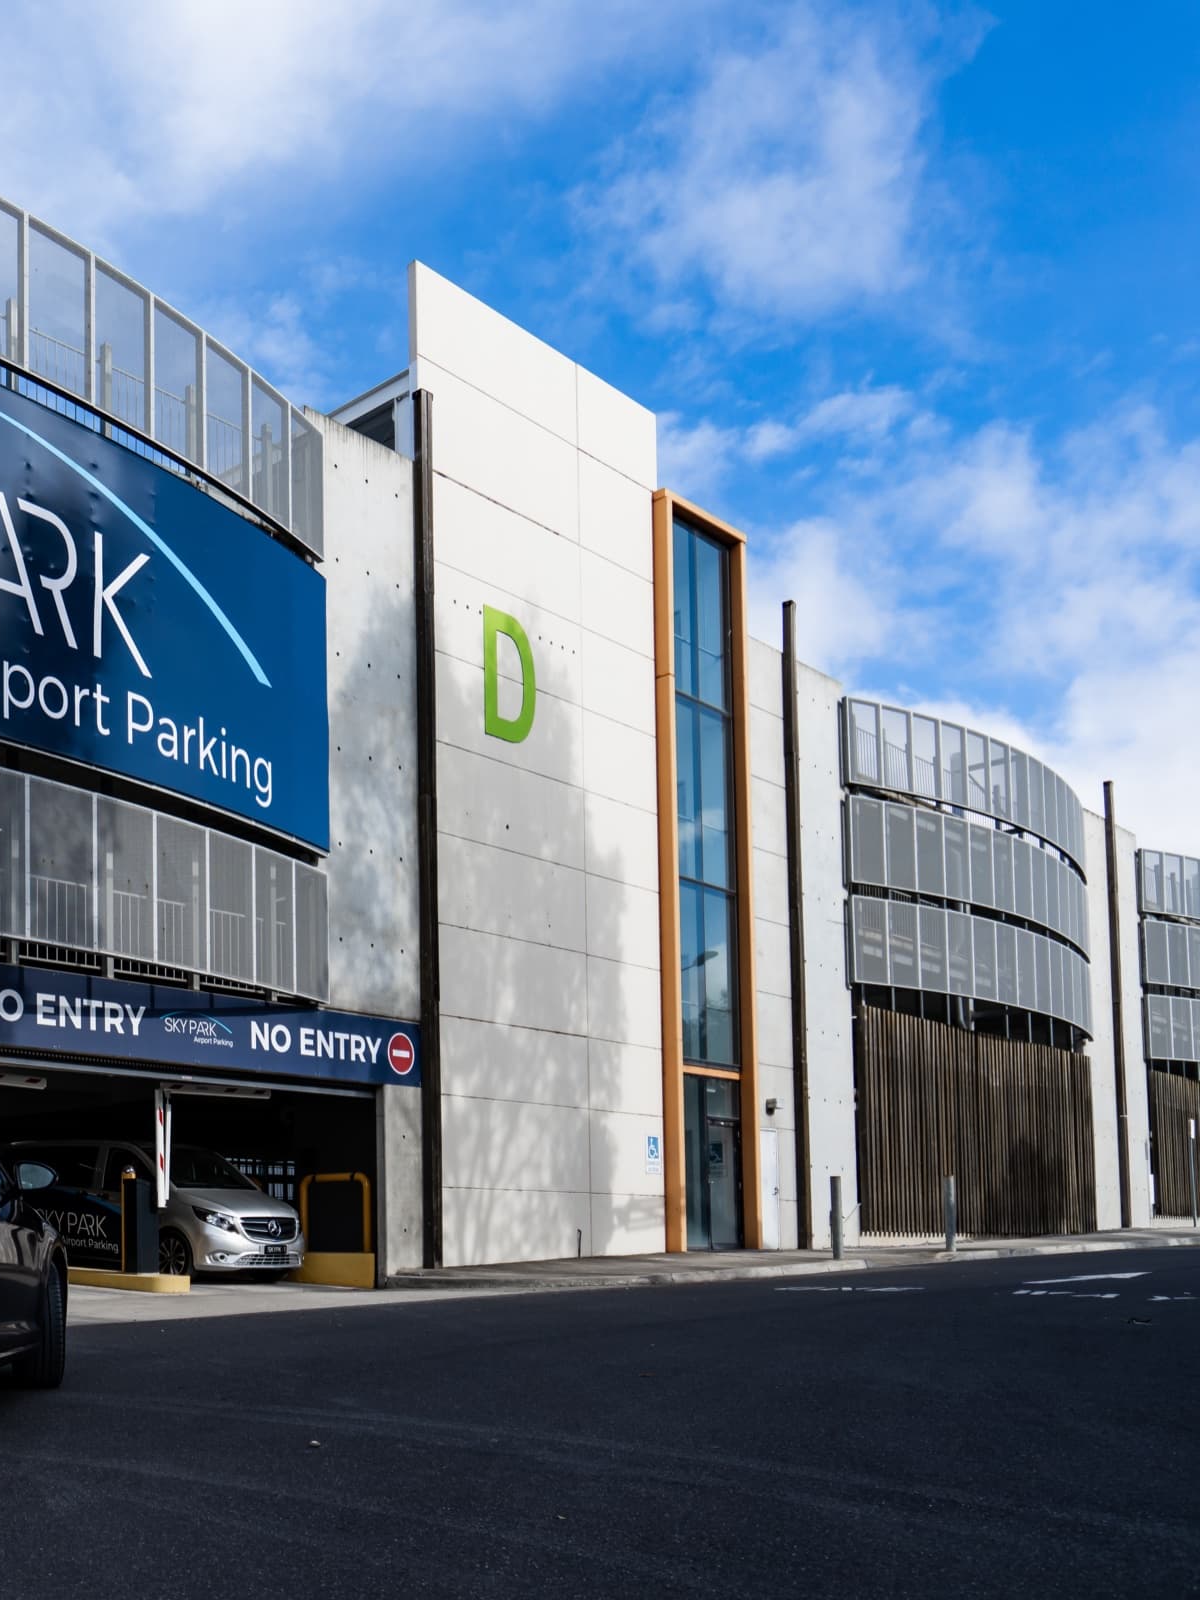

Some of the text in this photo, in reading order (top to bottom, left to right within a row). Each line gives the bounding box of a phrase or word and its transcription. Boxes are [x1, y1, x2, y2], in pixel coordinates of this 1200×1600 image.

[482, 604, 536, 744] D
[125, 696, 275, 811] Parking
[35, 992, 147, 1037] ENTRY
[164, 1016, 218, 1038] SKY PARK
[193, 1035, 234, 1048] Airport Parking
[249, 1021, 384, 1068] NO ENTRY
[66, 1211, 108, 1239] PARK
[88, 1238, 119, 1255] Parking
